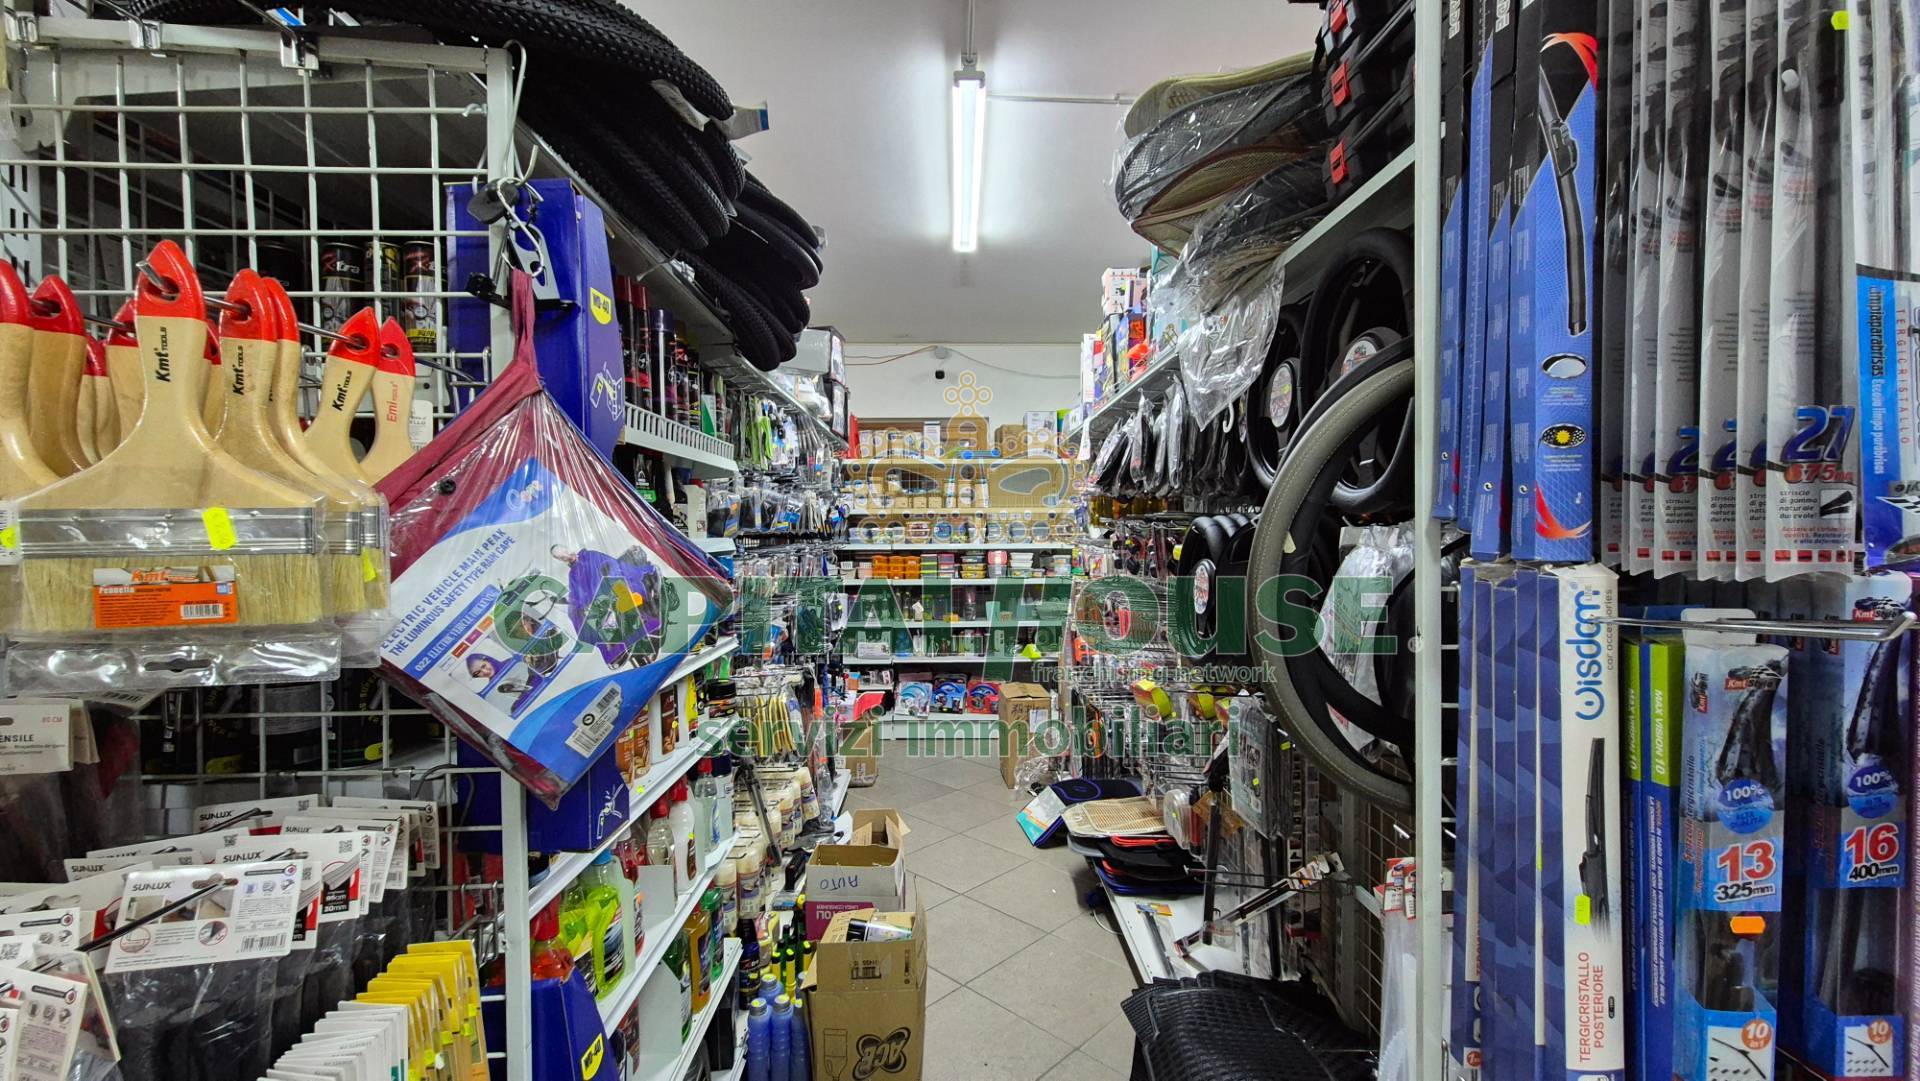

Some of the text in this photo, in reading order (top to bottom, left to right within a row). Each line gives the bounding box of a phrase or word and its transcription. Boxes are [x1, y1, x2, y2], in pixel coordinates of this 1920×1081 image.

[154, 326, 171, 382] Kmt TOOLS
[232, 366, 245, 396] Kmt
[1896, 308, 1910, 444] TERGICRISTALLO
[332, 386, 348, 412] Kmt
[1781, 406, 1856, 464] 27
[381, 605, 426, 650] ELECTRIC
[423, 569, 464, 605] VEHICLE
[460, 548, 485, 572] MAIN
[482, 528, 507, 551] PEAK
[389, 640, 409, 656] THE
[404, 605, 445, 643] LUMINOUS
[441, 581, 469, 608] SAFETY
[464, 567, 485, 586] TYPE
[495, 536, 516, 555] CAPE
[1854, 610, 1874, 619] Kmt
[1606, 658, 1614, 671] car
[1654, 689, 1665, 775] MAX VISION 10
[1855, 769, 1892, 788] 100%
[1726, 784, 1765, 802] 100%
[222, 851, 262, 864] SUNLUX
[1846, 823, 1900, 866] 16
[1718, 841, 1775, 881] 13
[1848, 863, 1900, 882] 400mm
[131, 881, 172, 892] SUNLUX
[819, 874, 859, 890] AUTO
[1716, 882, 1775, 902] 325mm
[1578, 951, 1590, 1062] TERGICRISTALLO
[1592, 964, 1605, 1048] POSTERIORE
[1746, 1023, 1769, 1038] 10
[1869, 1020, 1889, 1034] 10
